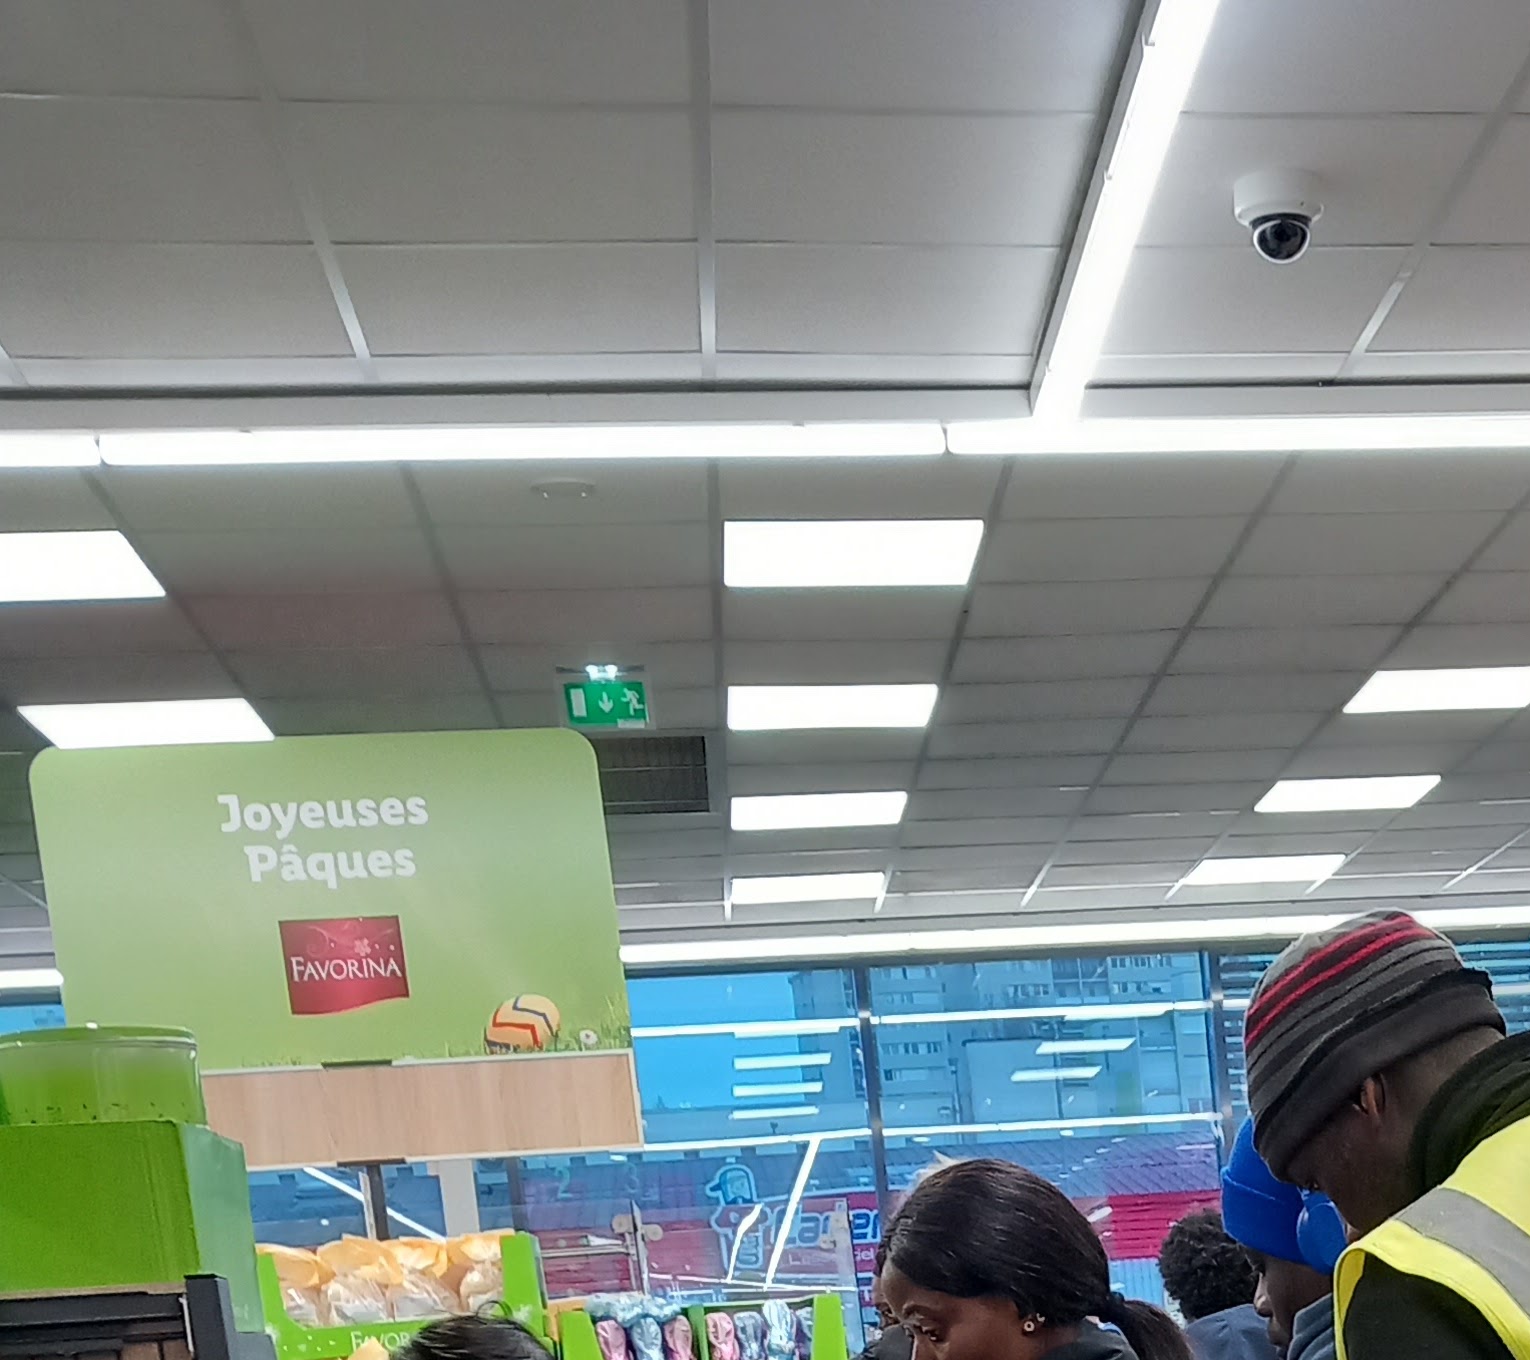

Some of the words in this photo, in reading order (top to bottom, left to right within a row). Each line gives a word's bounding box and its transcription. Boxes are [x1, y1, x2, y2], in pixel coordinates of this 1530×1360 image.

[217, 794, 429, 840] Joyeuses
[243, 842, 417, 889] Pâques
[291, 955, 402, 984] FAVORINA
